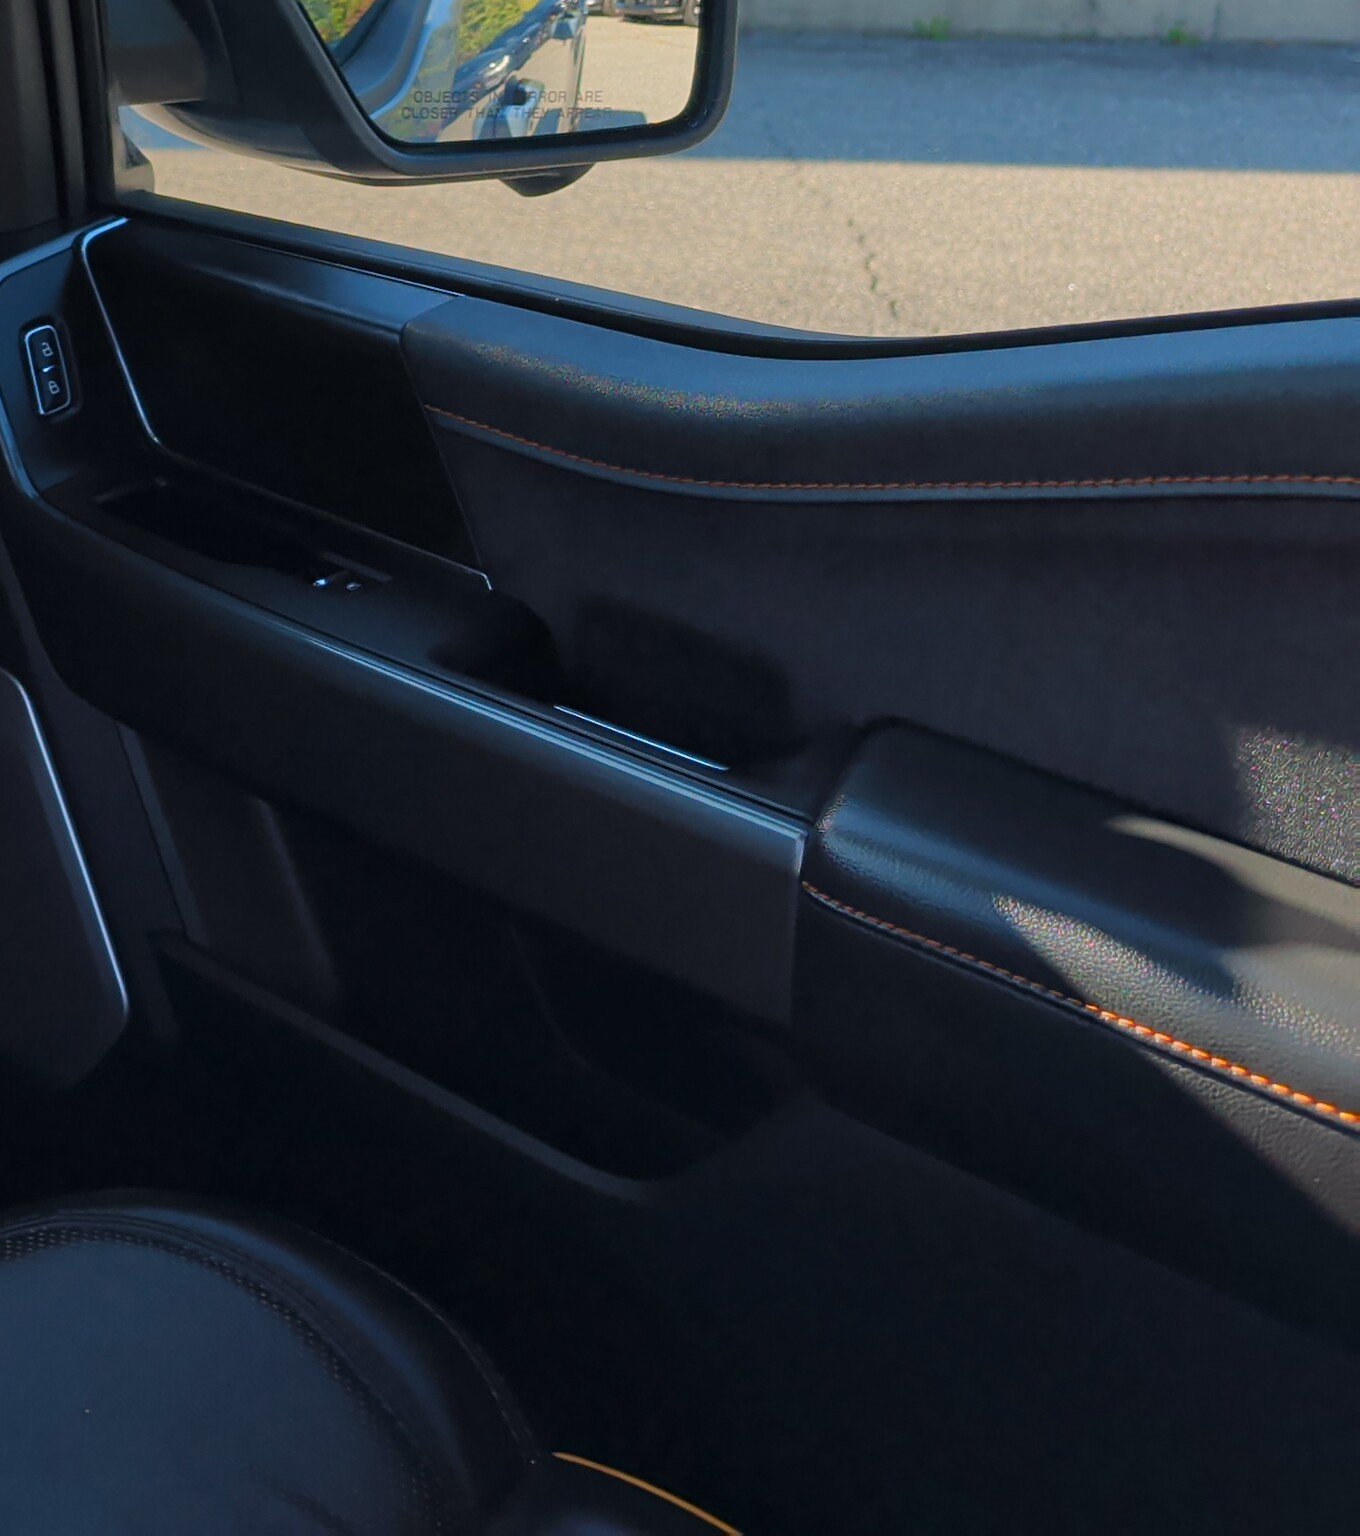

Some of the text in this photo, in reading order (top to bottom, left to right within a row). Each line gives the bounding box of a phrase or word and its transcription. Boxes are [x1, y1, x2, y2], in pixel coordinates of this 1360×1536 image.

[413, 90, 479, 104] OBJECTS
[575, 90, 604, 103] ARE
[401, 106, 458, 120] CLOSER
